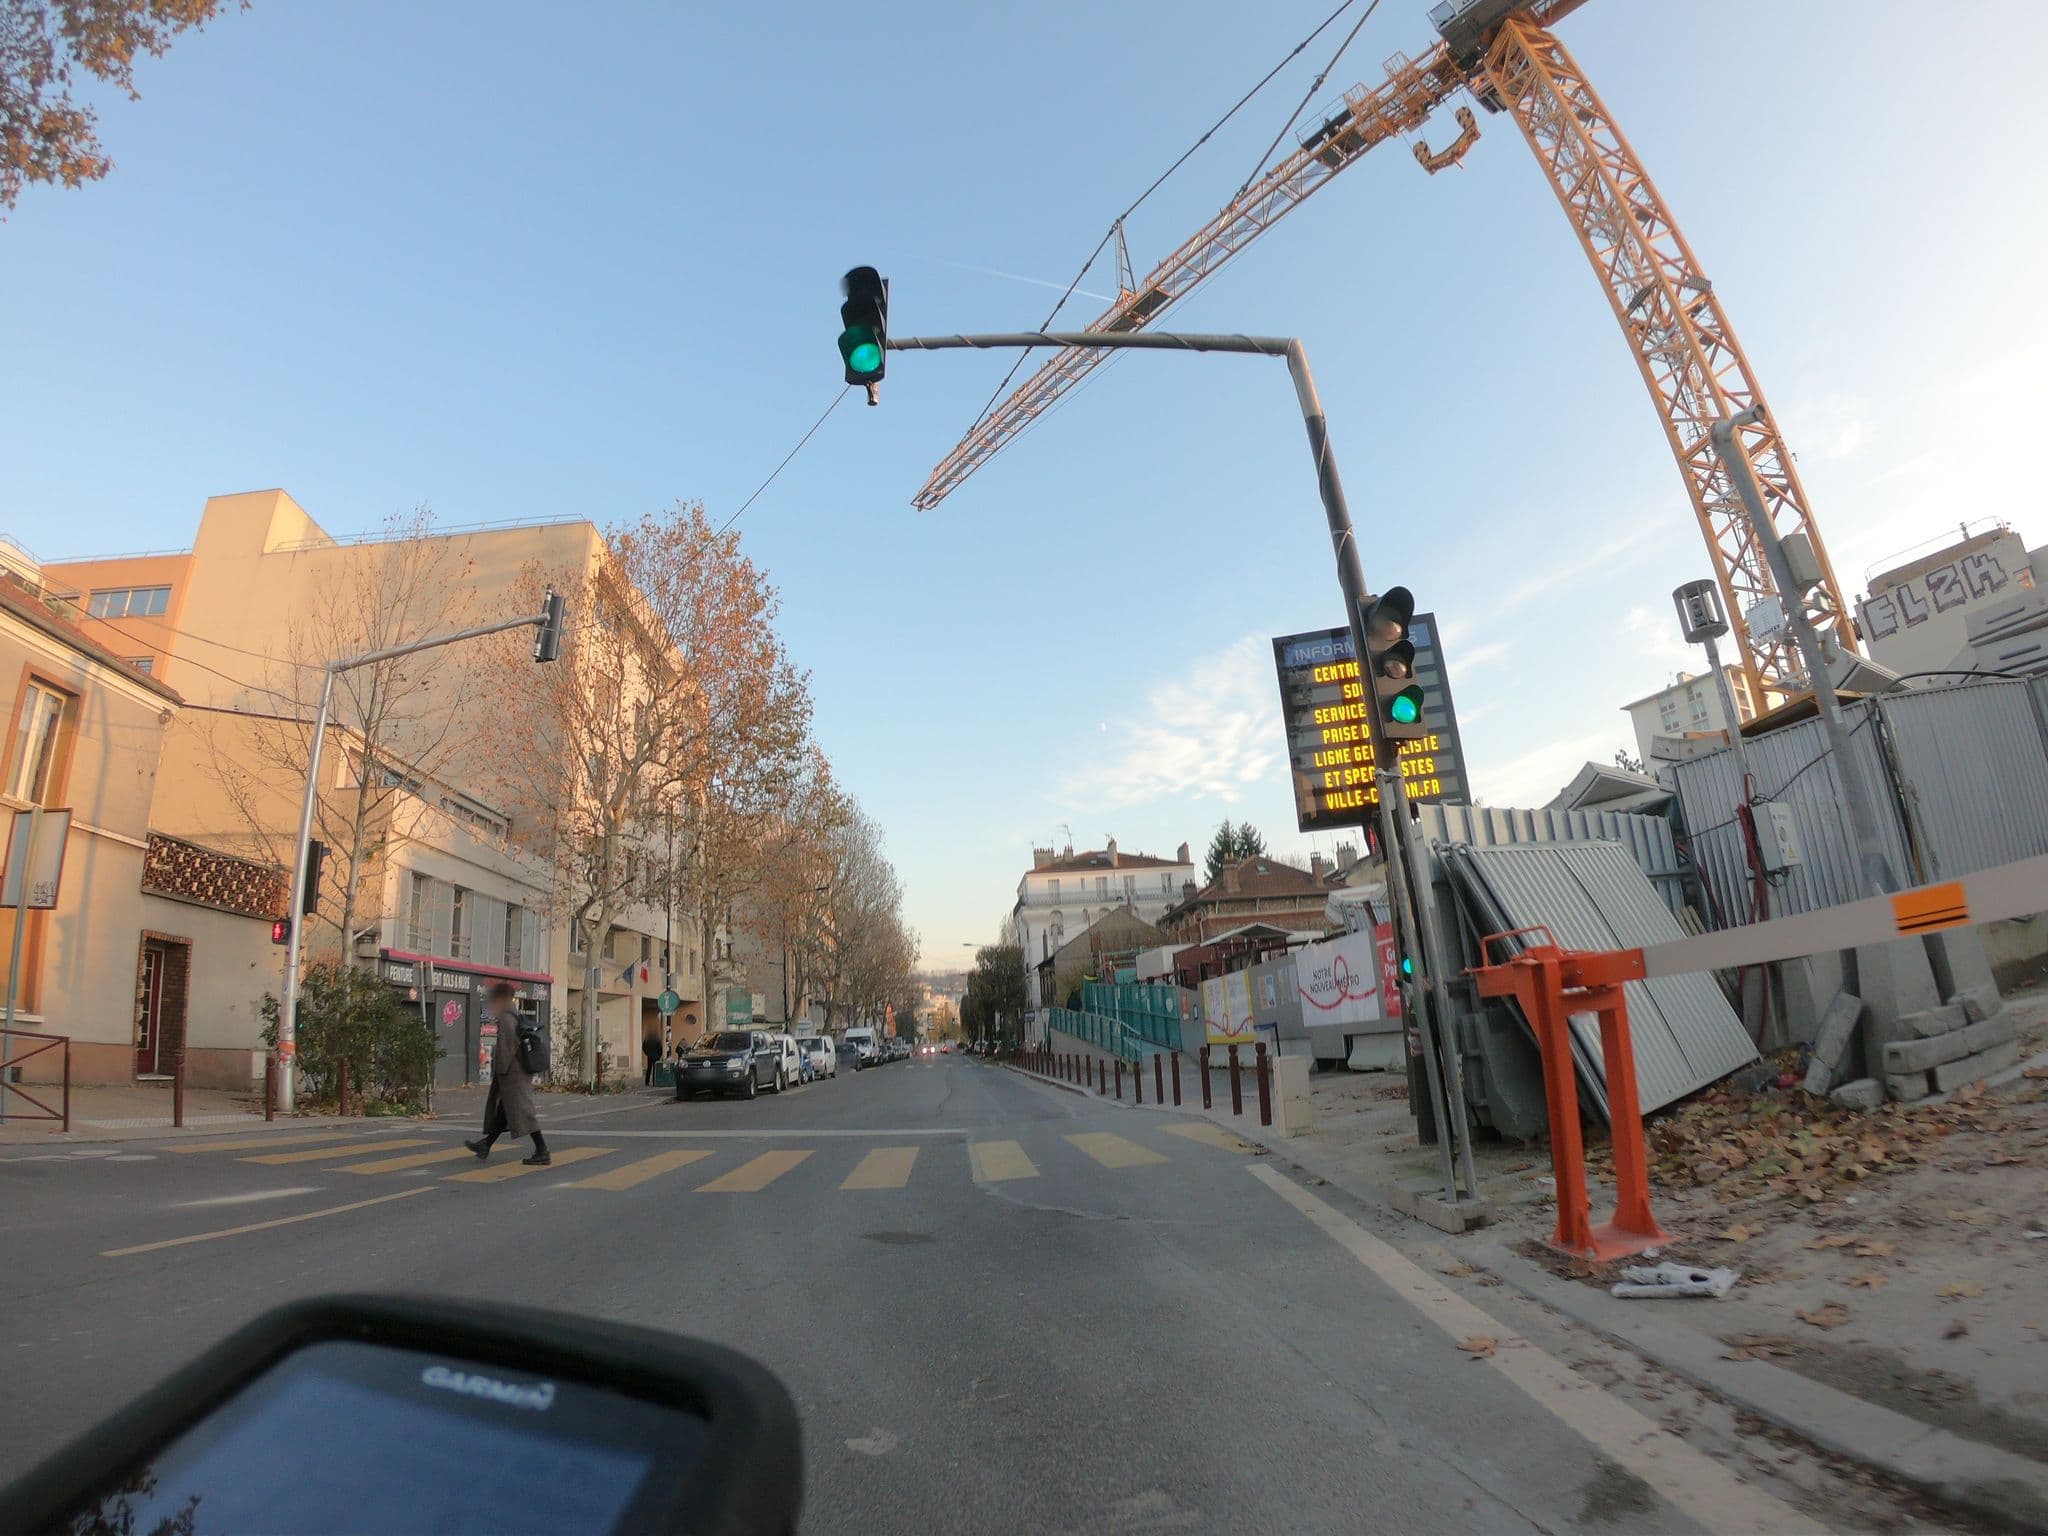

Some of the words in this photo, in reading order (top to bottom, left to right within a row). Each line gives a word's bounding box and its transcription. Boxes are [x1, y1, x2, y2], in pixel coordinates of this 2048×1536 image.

[1314, 662, 1360, 682] CENTRE
[1343, 683, 1363, 699] SO
[1314, 703, 1366, 724] SERVICE
[1322, 725, 1359, 744] PRISE
[1315, 748, 1351, 767] LIGNE
[1325, 771, 1340, 788] ET
[1312, 967, 1331, 981] NOTRE
[1309, 979, 1336, 994] NOUVEAU
